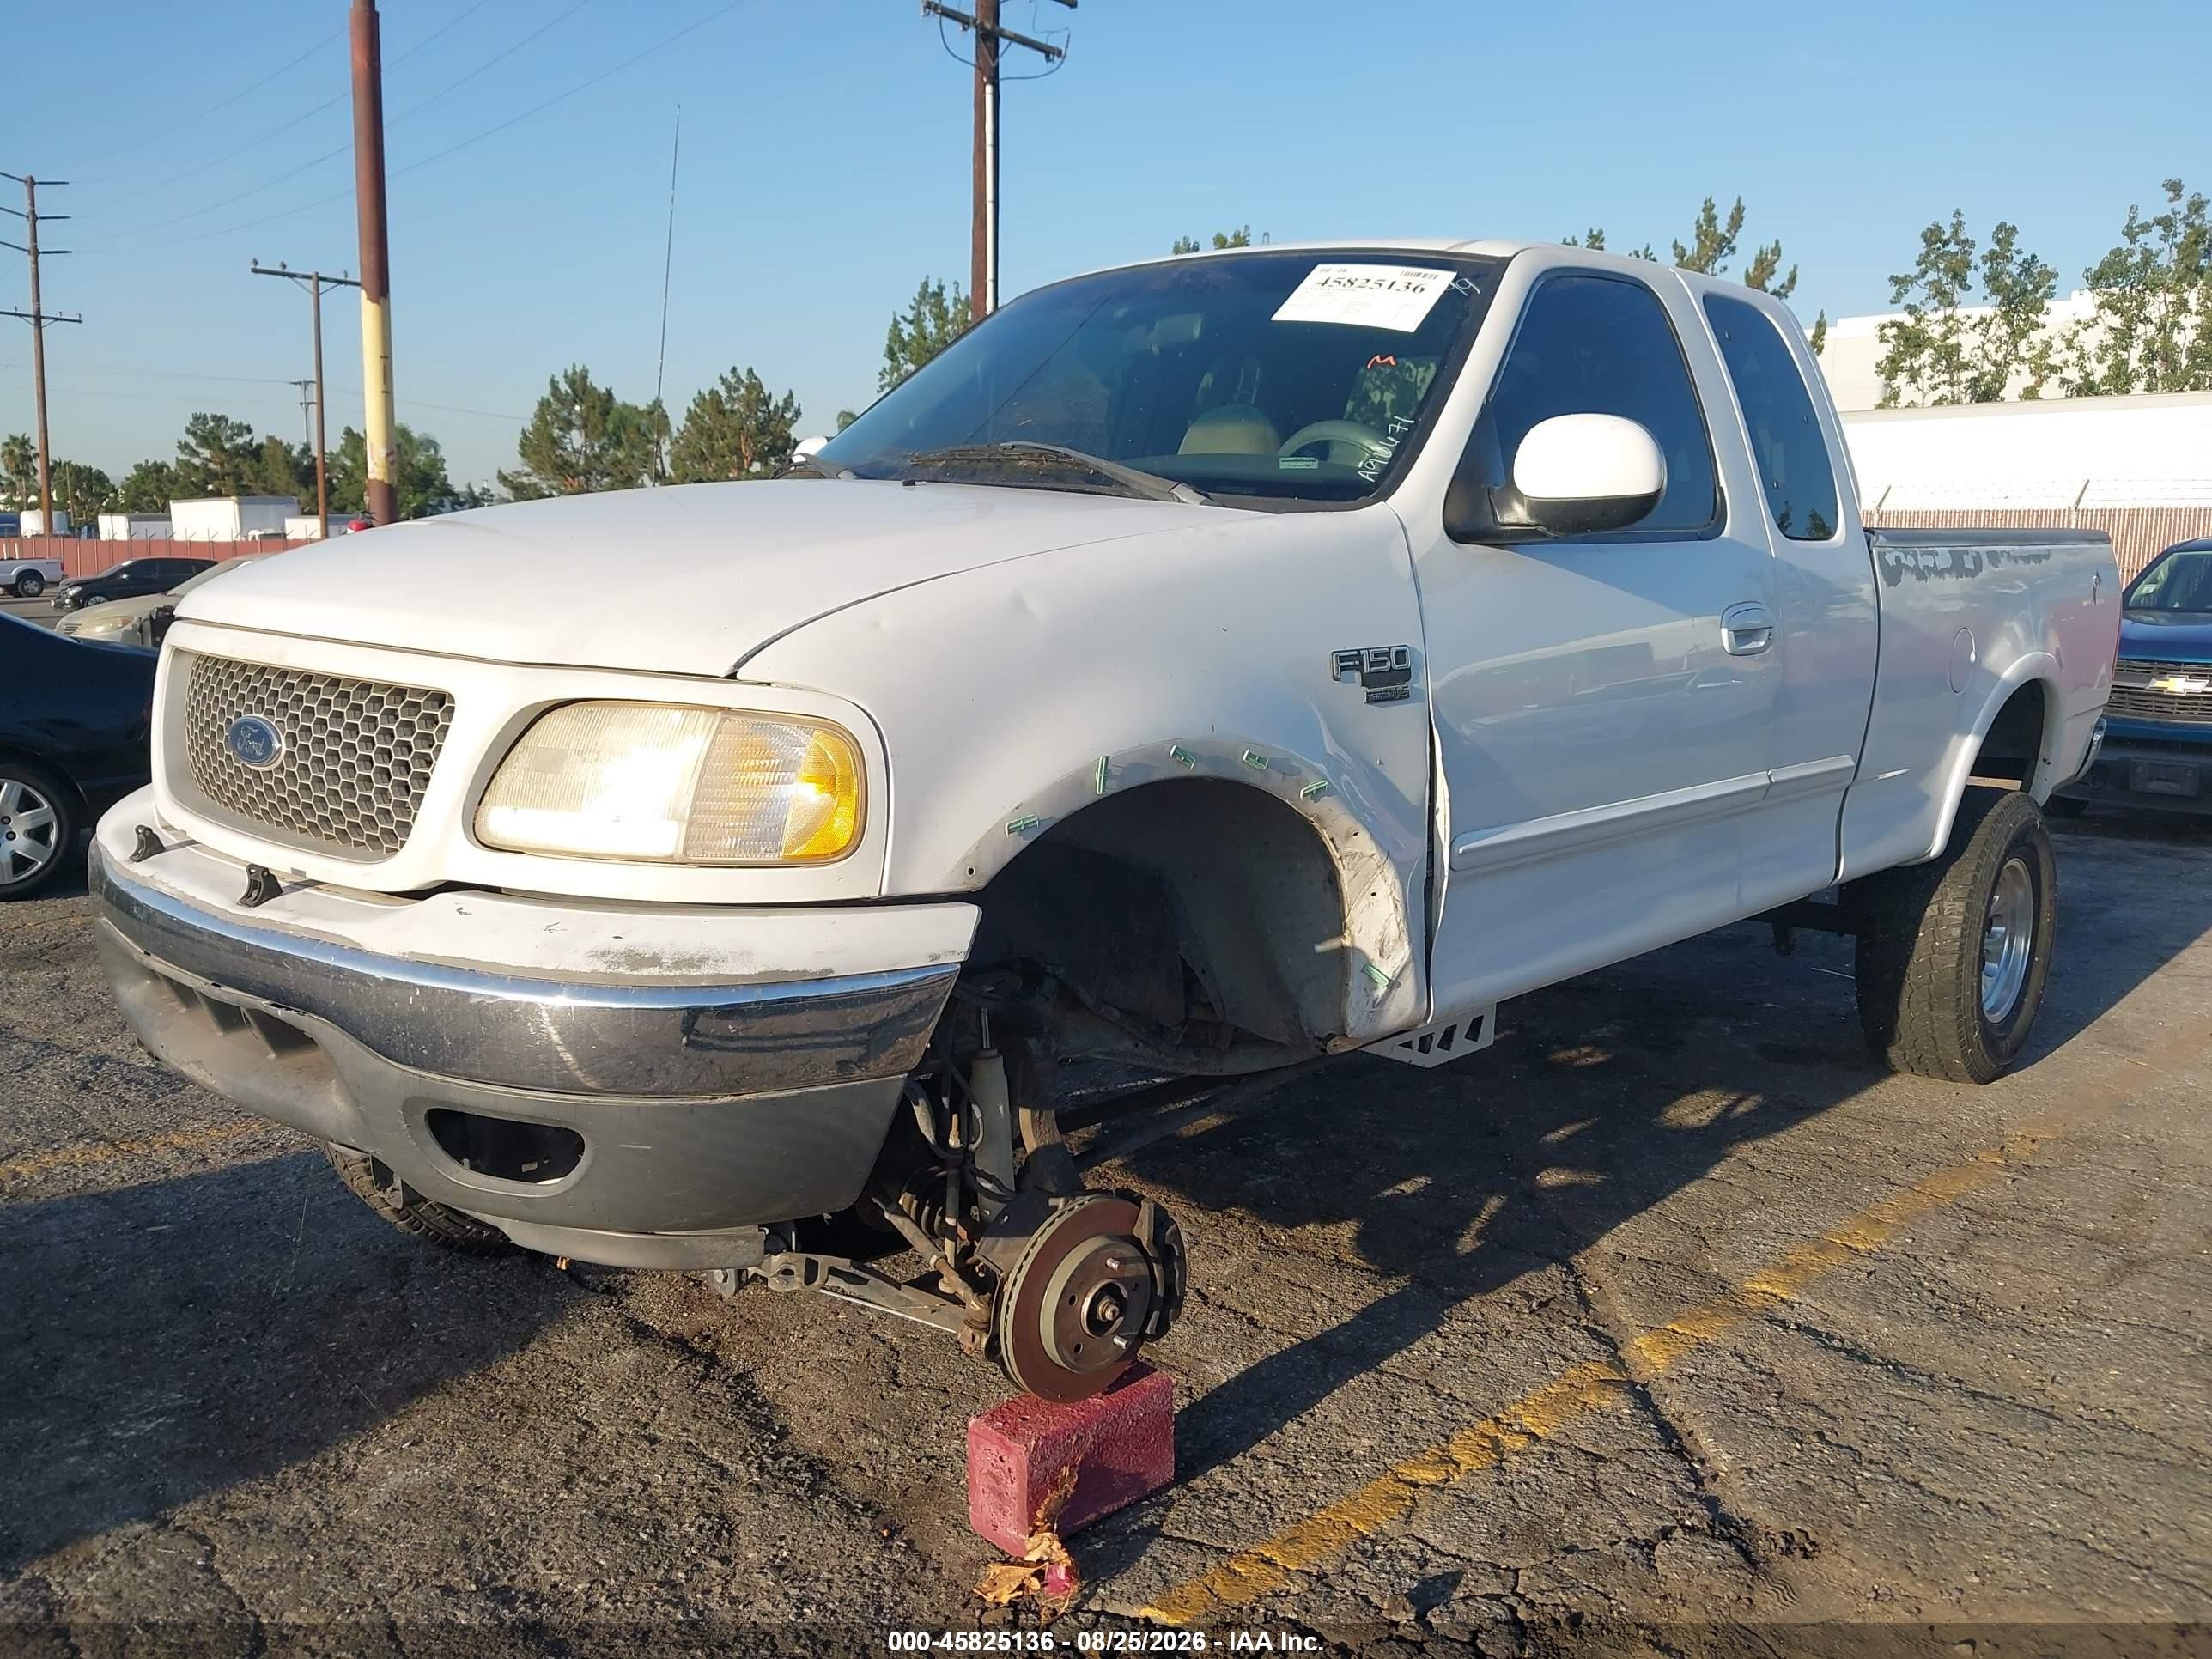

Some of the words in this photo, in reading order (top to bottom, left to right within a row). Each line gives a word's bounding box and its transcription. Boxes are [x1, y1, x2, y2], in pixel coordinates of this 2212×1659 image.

[1316, 276, 1428, 295] 45825136
[1332, 646, 1411, 680] F-150
[237, 725, 265, 756] Ford
